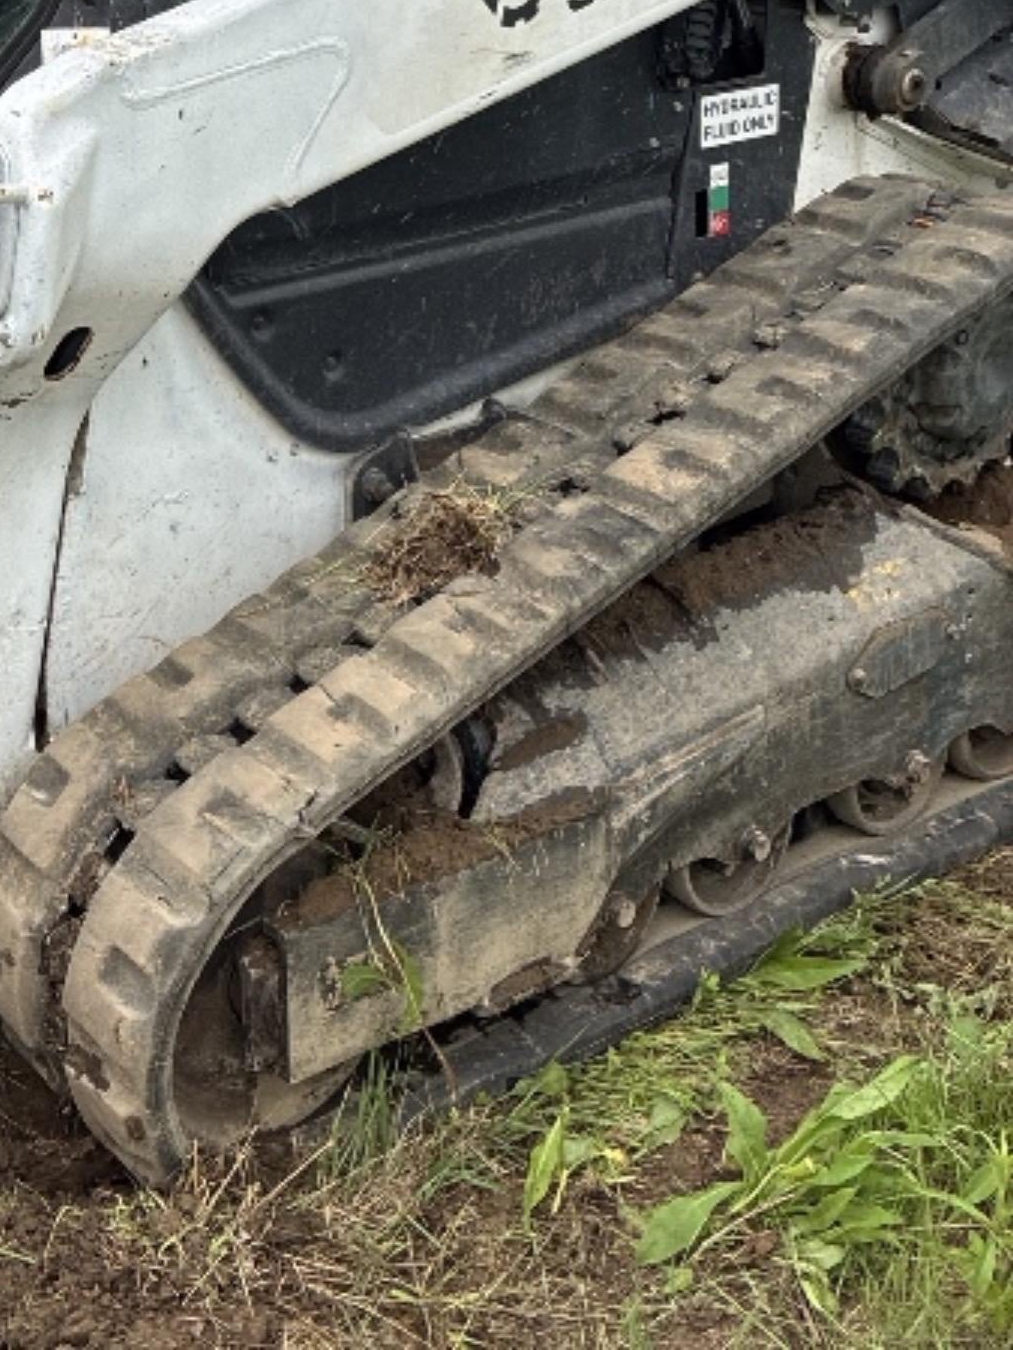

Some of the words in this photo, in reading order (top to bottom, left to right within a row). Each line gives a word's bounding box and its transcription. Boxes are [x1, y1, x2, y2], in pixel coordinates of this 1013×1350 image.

[704, 89, 778, 117] HYDRAULIC
[704, 120, 741, 141] FLUID
[742, 114, 774, 133] ONLY
